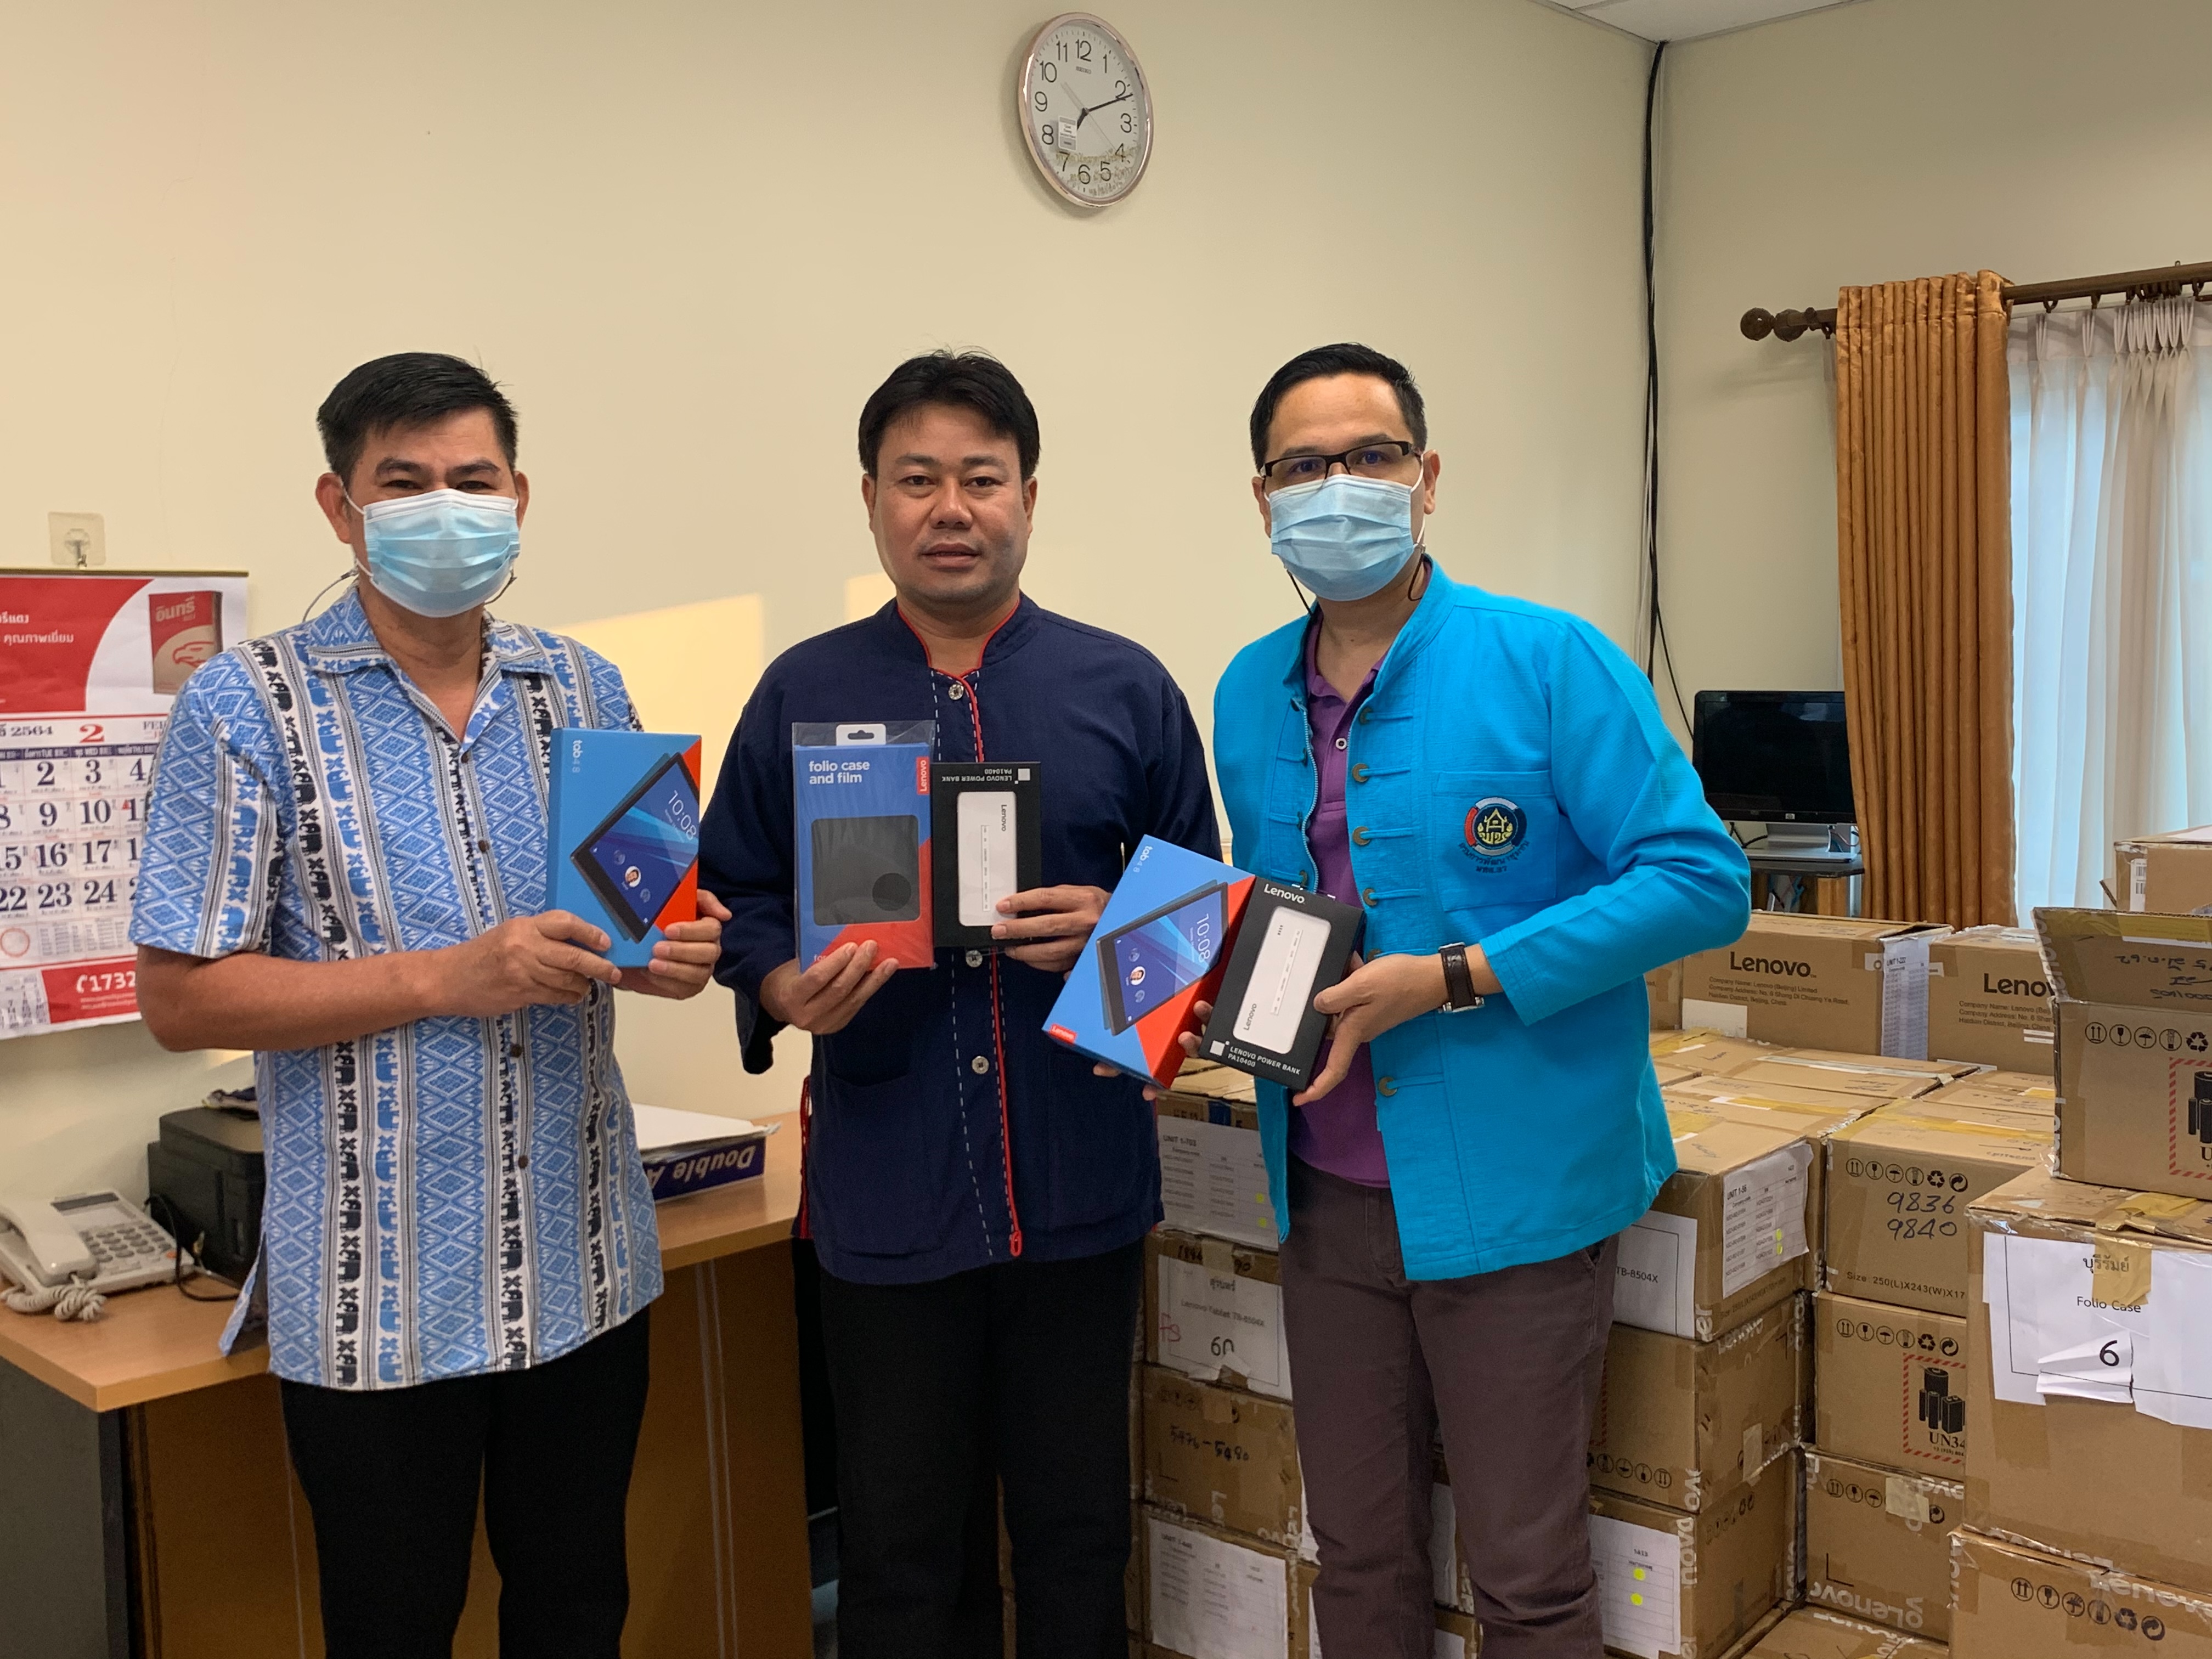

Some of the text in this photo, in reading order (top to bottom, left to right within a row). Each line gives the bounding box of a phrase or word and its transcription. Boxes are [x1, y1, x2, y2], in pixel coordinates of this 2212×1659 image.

[1056, 41, 1068, 63] 11
[1075, 39, 1091, 62] 12
[1040, 60, 1057, 83] 10
[1103, 54, 1107, 74] 1
[1115, 80, 1126, 101] 2
[1035, 91, 1047, 112] 9
[1120, 113, 1132, 133] 3
[1042, 125, 1054, 145] 8
[1059, 151, 1070, 172] 7
[1115, 143, 1126, 162] 4
[1078, 164, 1091, 184] 6
[1100, 161, 1111, 181] 5
[10, 725, 53, 737] 2564
[79, 724, 105, 743] 2
[573, 739, 583, 758] tab
[37, 758, 147, 786] 2 3 4
[809, 760, 870, 772] folio case
[919, 759, 928, 792] Lenovo
[809, 771, 862, 785] and film
[40, 802, 58, 827] 9
[80, 799, 112, 825] 10
[667, 790, 697, 841] 10:08
[36, 843, 68, 868] 16
[82, 839, 112, 865] 17
[1141, 845, 1153, 862] tab
[38, 882, 72, 909] 23
[84, 879, 118, 905] 24
[1263, 883, 1306, 904] Lenovo
[1729, 951, 1812, 978] Lenovo
[1959, 1001, 1989, 1010] Company
[1959, 1009, 1989, 1018] Company
[1243, 1003, 1257, 1031] Lenovo
[1228, 1053, 1256, 1068] PA10400
[1229, 1046, 1301, 1075] LENOVO POWER BANK
[673, 1145, 757, 1183] Double
[1887, 1192, 1956, 1214] 9836
[1887, 1218, 1957, 1241] 9840
[1847, 1271, 1866, 1283] Size
[2076, 1296, 2142, 1313] Folio Case
[2099, 1339, 2120, 1367] 6
